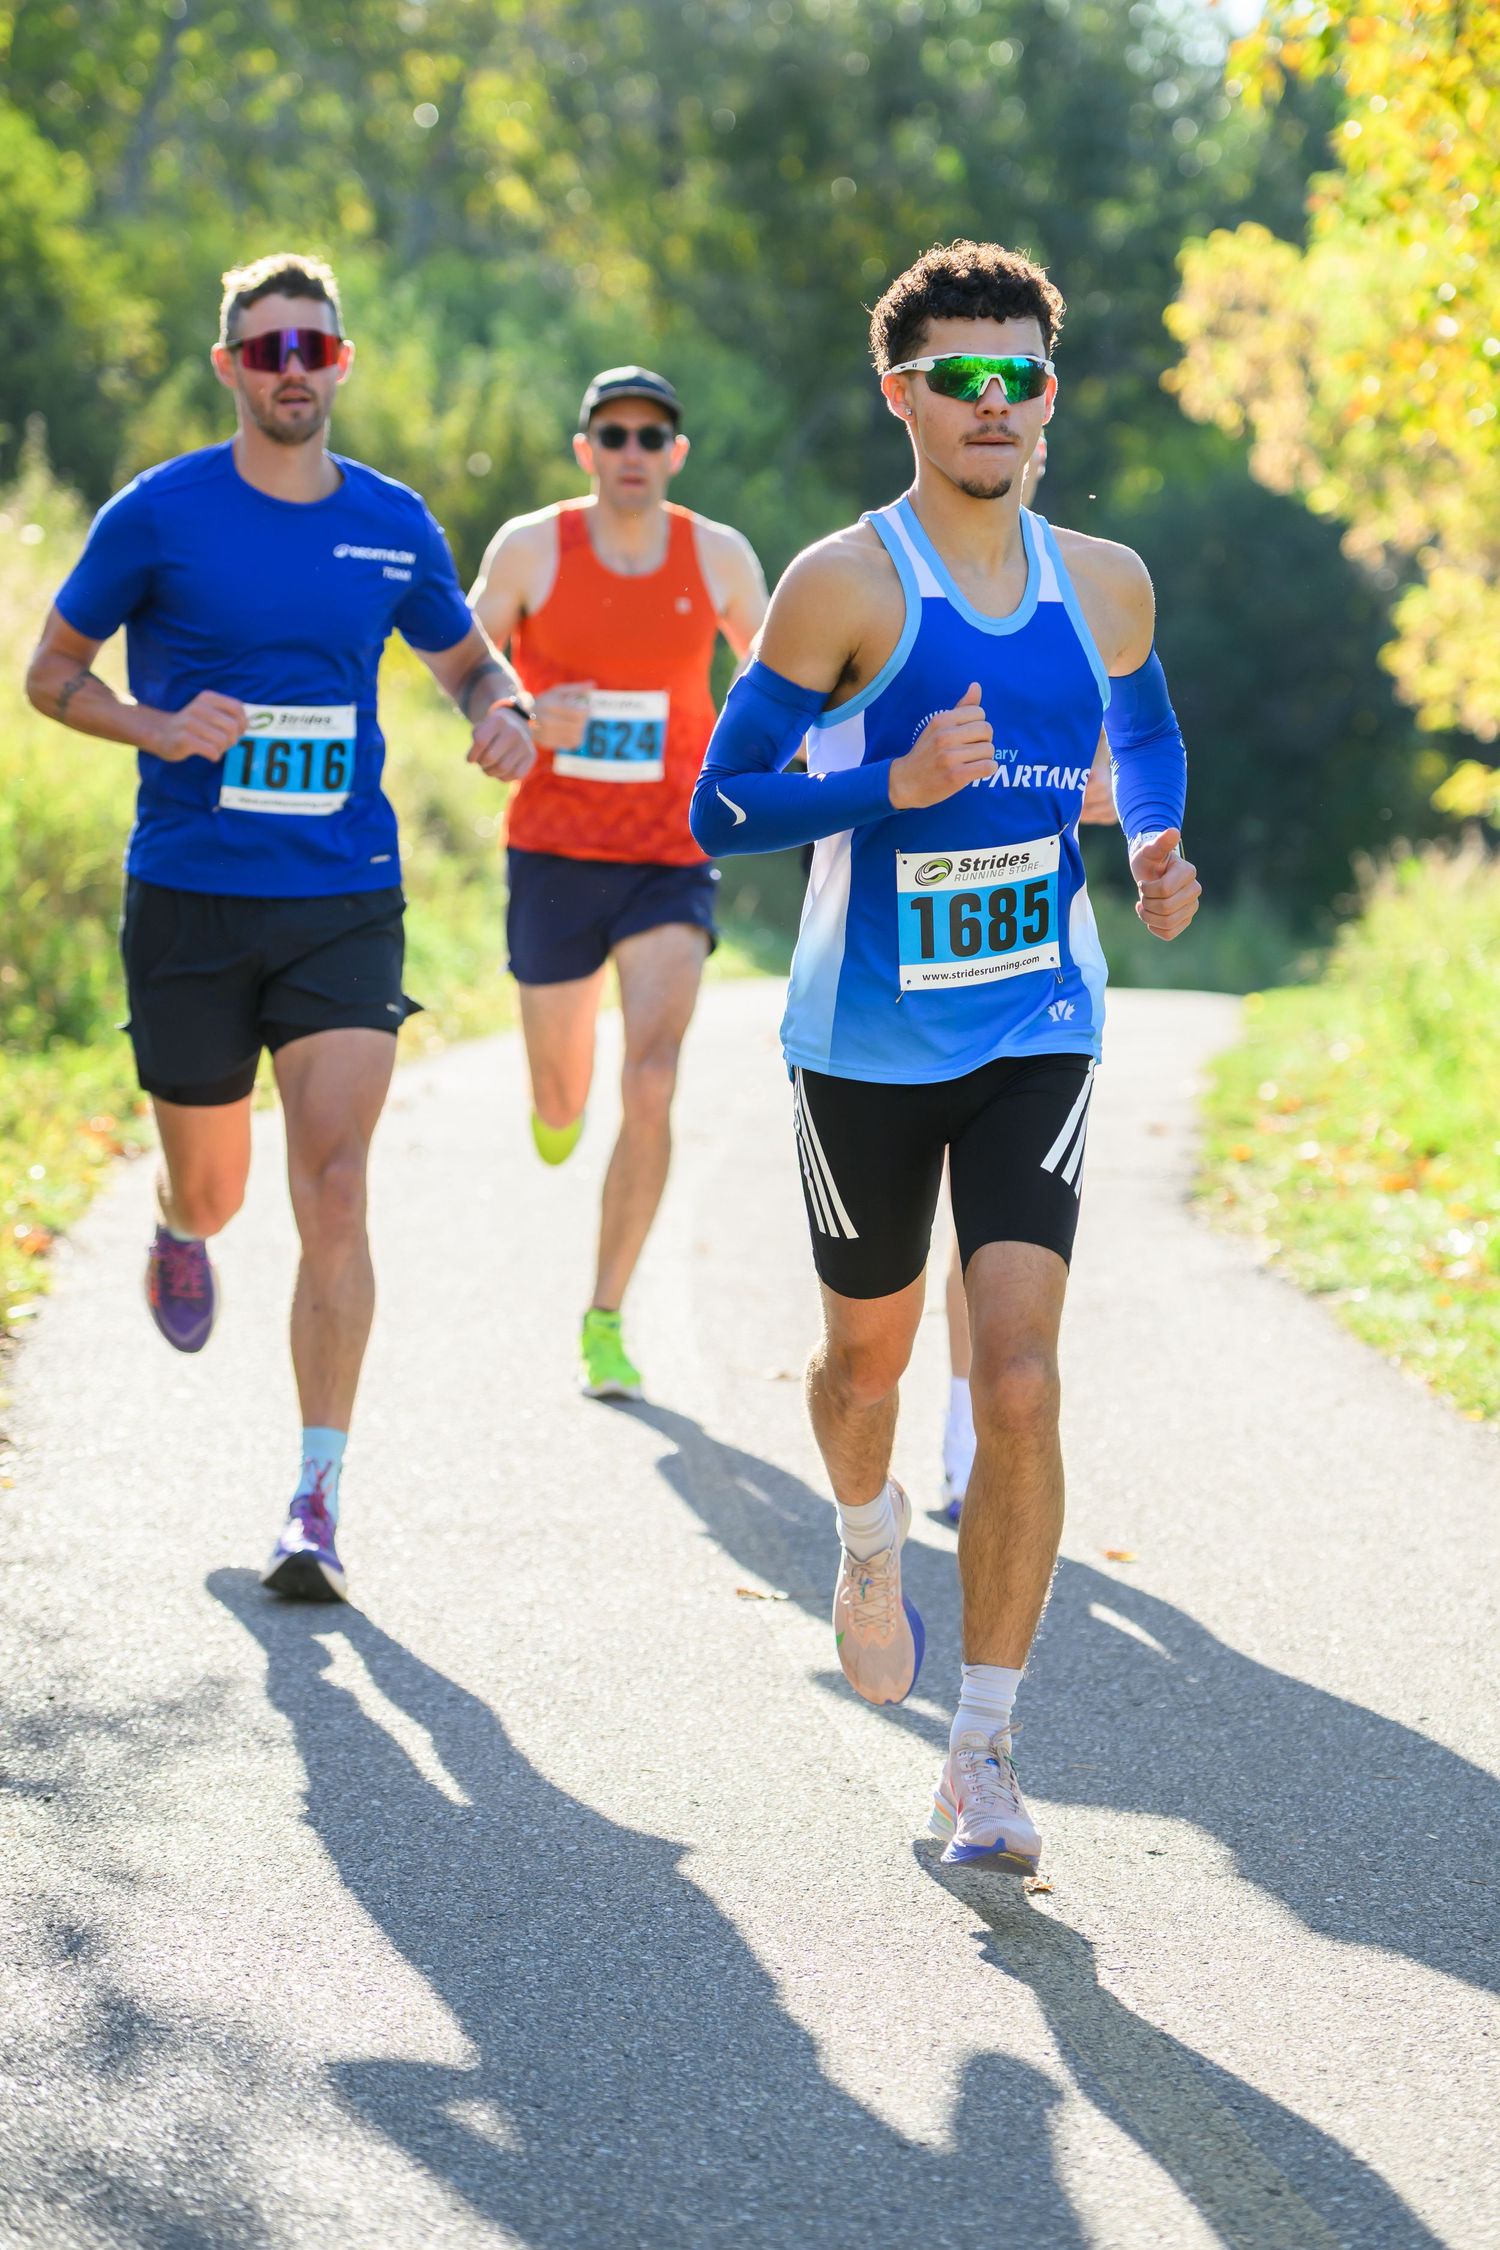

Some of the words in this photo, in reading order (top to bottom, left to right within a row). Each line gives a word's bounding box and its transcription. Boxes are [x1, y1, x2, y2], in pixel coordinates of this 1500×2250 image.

[587, 719, 657, 760] 624
[239, 740, 346, 790] 1616
[992, 748, 1019, 763] ary
[954, 868, 1005, 883] RUNNING
[1008, 862, 1039, 876] STORE
[958, 852, 1031, 873] Strides
[910, 879, 1050, 960] 1685
[921, 955, 1041, 982] www.stridesrunning.com
